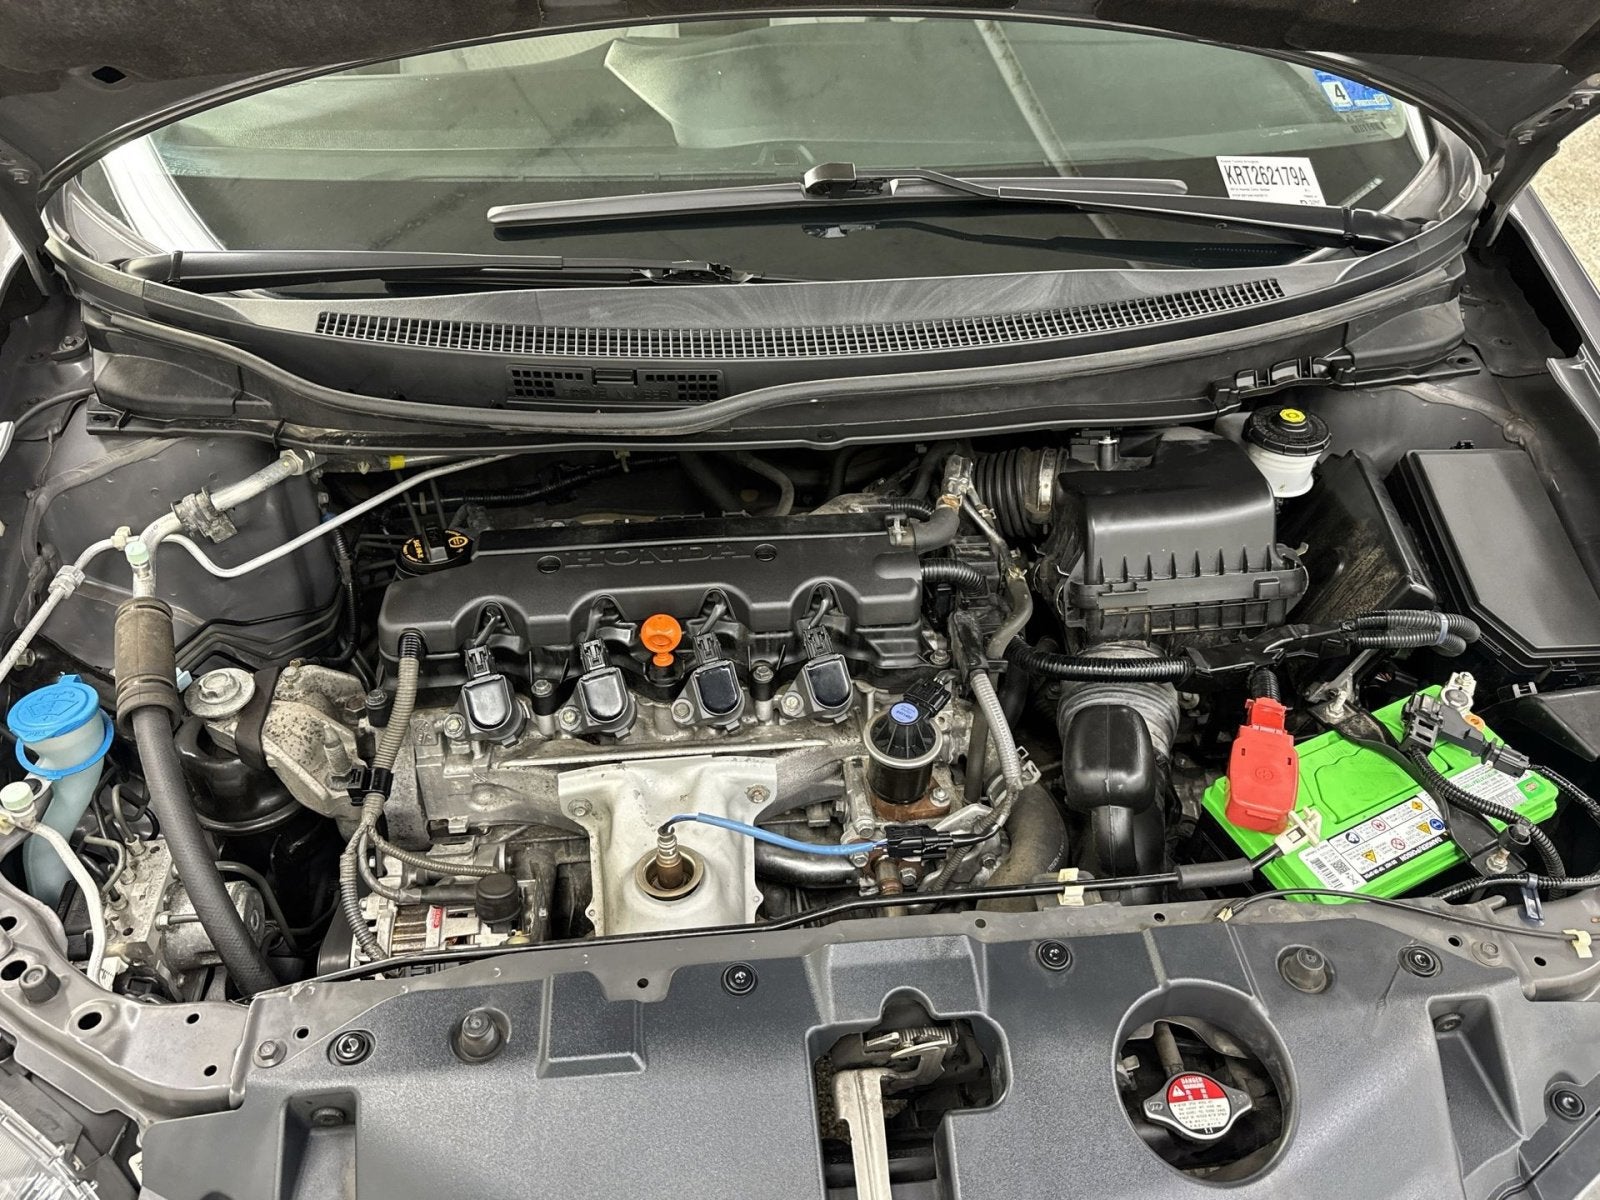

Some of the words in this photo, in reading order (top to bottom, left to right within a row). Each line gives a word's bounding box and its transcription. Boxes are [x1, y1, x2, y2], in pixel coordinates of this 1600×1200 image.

[1335, 84, 1346, 100] 4
[1224, 165, 1310, 186] KRT262179A
[564, 545, 751, 568] HONDA
